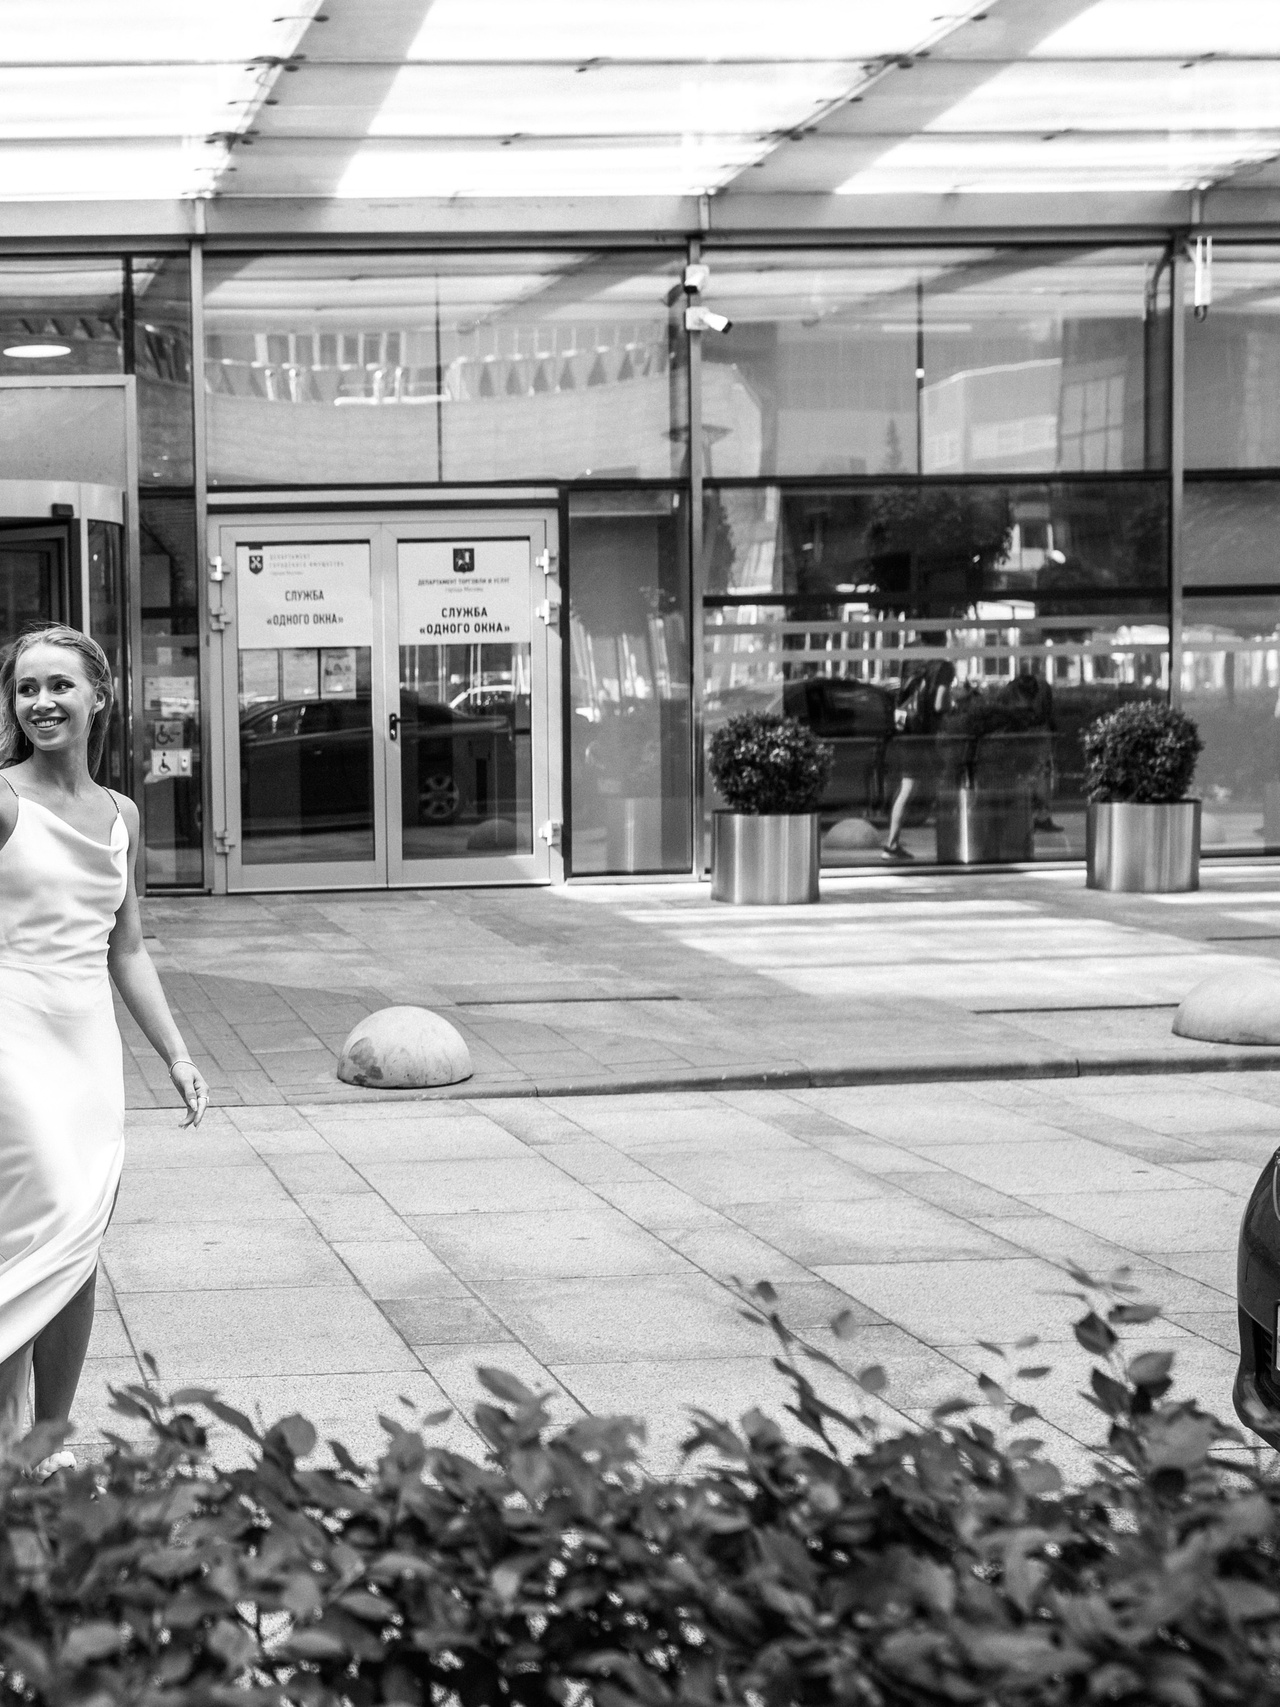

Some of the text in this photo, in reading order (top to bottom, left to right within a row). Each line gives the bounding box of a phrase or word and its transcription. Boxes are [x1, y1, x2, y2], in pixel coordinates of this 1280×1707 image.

[285, 589, 325, 602] СЛУЖБА
[441, 607, 488, 618] СЛУЖБА
[266, 613, 344, 626] «ОДНОГО ОКНА»
[419, 622, 510, 636] «ОДНОГО ОКНА»
